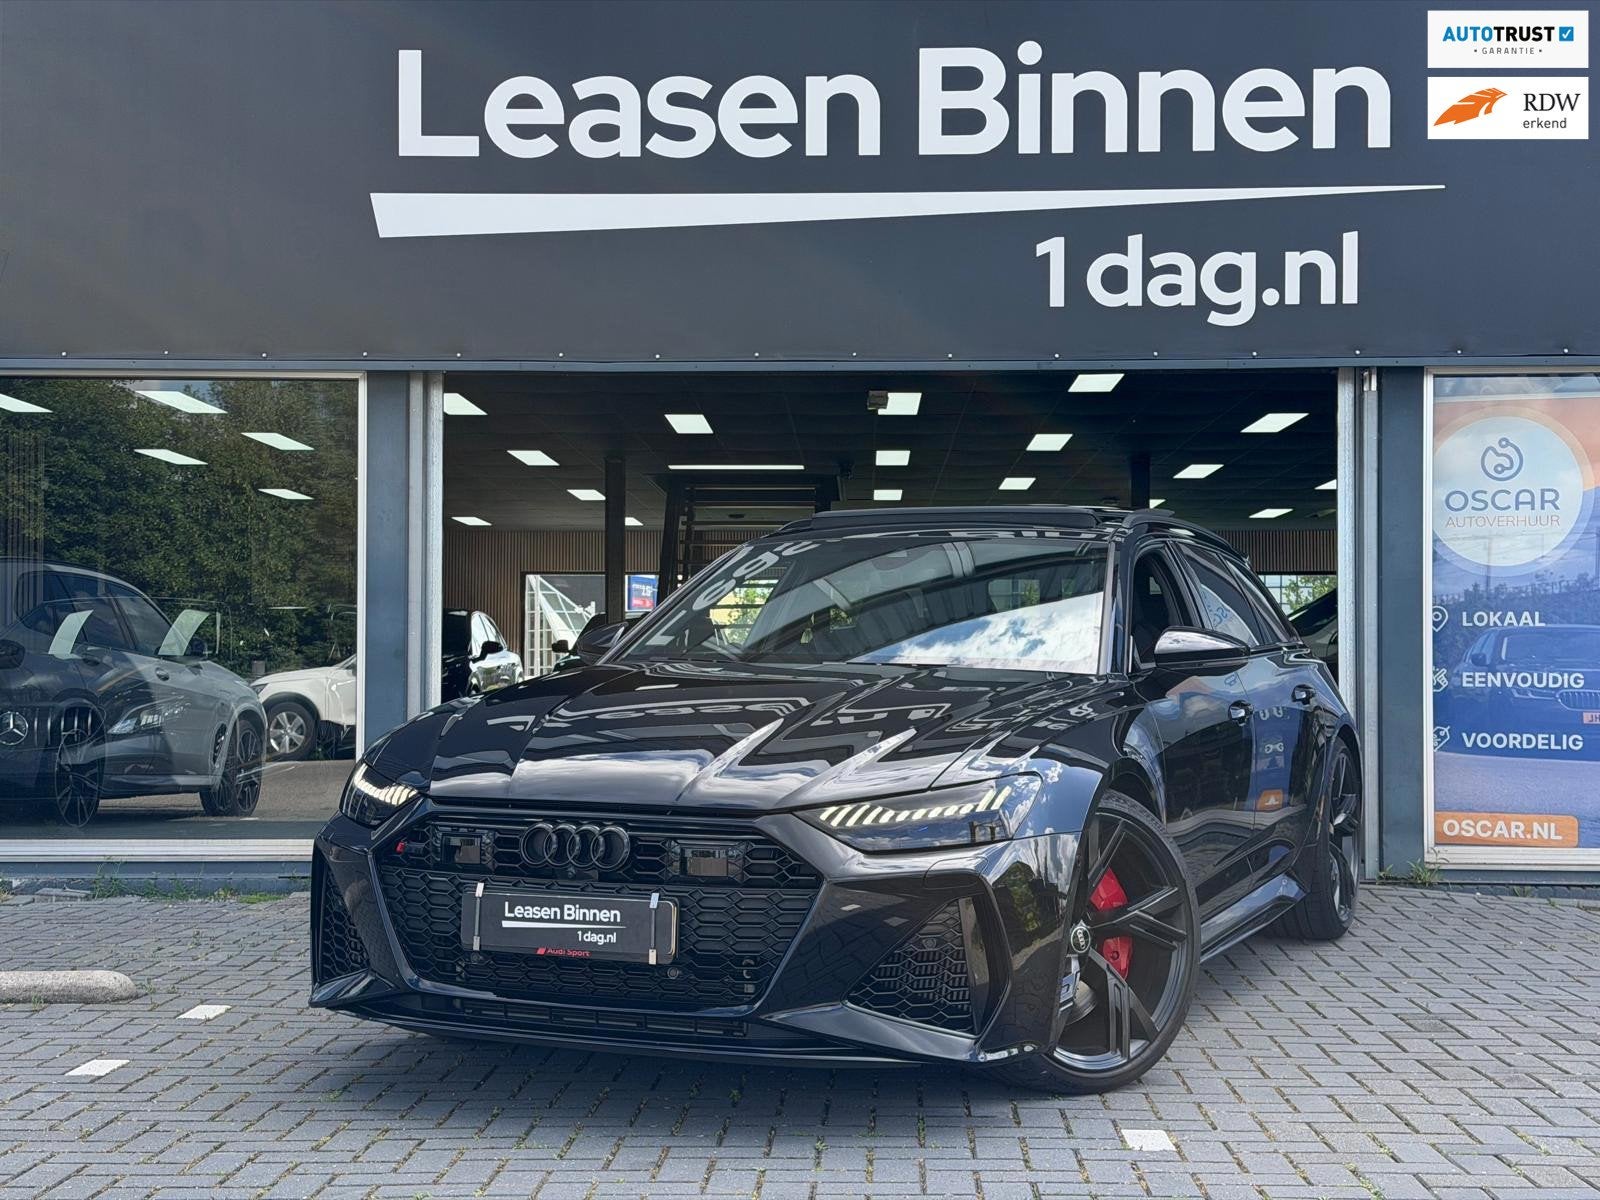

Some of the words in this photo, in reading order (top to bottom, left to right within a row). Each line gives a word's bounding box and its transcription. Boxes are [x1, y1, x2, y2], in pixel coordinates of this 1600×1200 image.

[398, 49, 881, 159] Leasen
[919, 41, 1391, 156] Binnen
[1445, 488, 1561, 512] OSCAR
[1445, 515, 1561, 528] AUTOVERHUUR
[1462, 611, 1546, 627] LOKAAL
[1462, 671, 1585, 689] EENVOUDIG
[1462, 732, 1584, 750] VOORDELIG
[1443, 819, 1563, 840] OSCAR.NL
[504, 901, 560, 920] Leasen
[564, 904, 621, 923] Binnen
